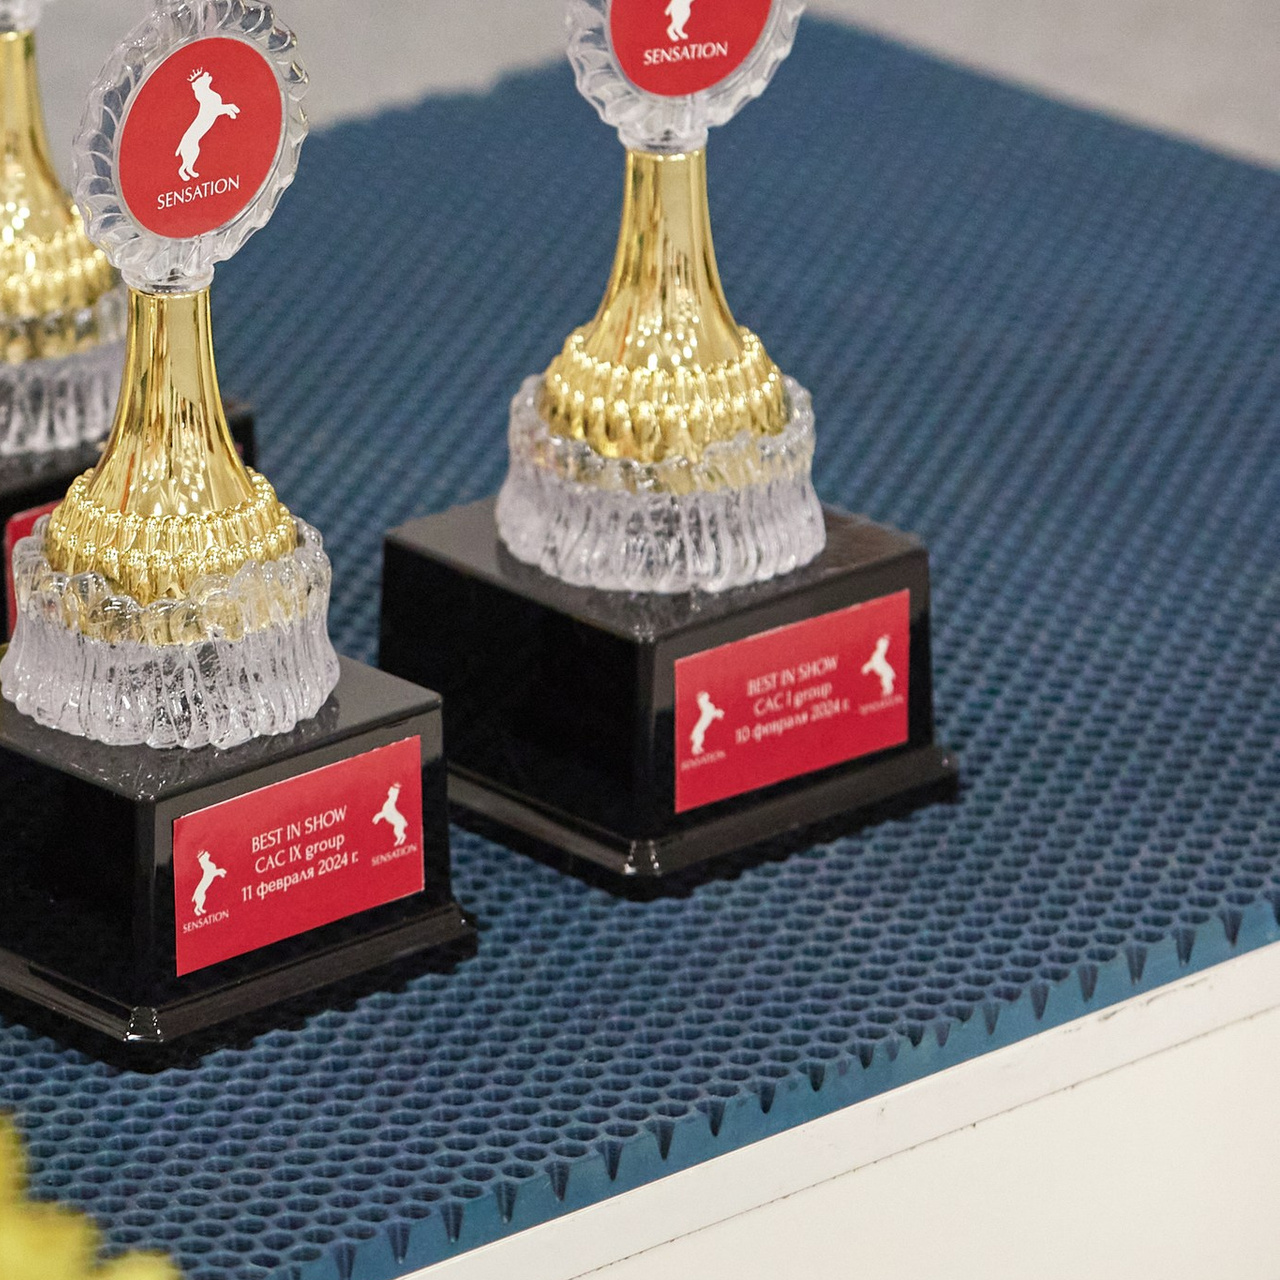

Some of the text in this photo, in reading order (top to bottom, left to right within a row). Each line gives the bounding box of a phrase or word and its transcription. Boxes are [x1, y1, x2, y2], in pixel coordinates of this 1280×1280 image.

[643, 41, 728, 66] SENSATION
[157, 175, 239, 210] SENSATION
[747, 654, 838, 696] BEST IN SHOW
[753, 692, 784, 716] CAC
[793, 682, 832, 708] group
[735, 725, 750, 744] 10
[810, 699, 840, 721] 2024
[251, 805, 347, 853] BEST IN SHOW
[254, 834, 345, 874] CAC IX group
[371, 843, 417, 867] SENSATION
[241, 886, 253, 902] 11
[257, 865, 314, 900] февраля
[318, 853, 349, 875] 2024
[183, 910, 229, 934] SENSATION
